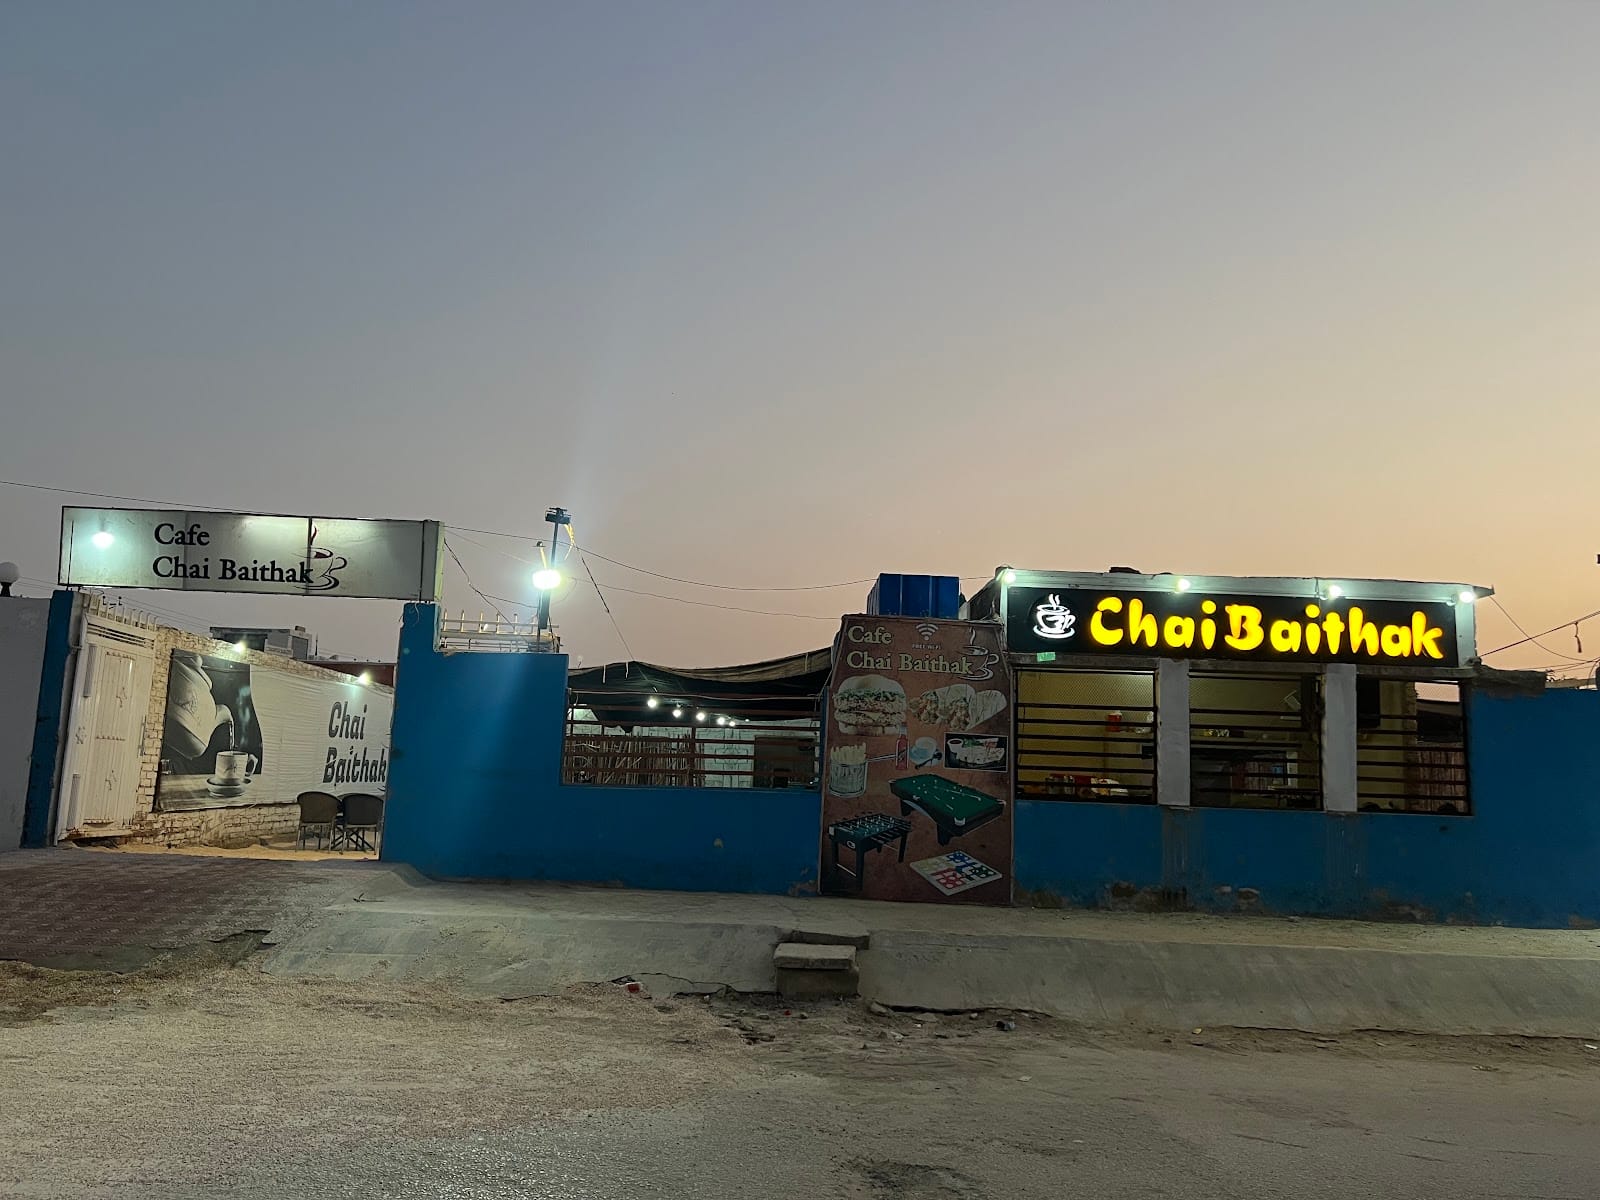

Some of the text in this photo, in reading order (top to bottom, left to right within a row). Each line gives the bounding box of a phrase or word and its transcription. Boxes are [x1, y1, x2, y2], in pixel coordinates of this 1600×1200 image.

[154, 523, 210, 546] Cafe
[152, 556, 313, 584] Chai Baithak
[847, 625, 892, 644] Cafe
[847, 651, 973, 675] Chai Baithak
[328, 701, 367, 740] Chai
[322, 746, 387, 784] Baithak
